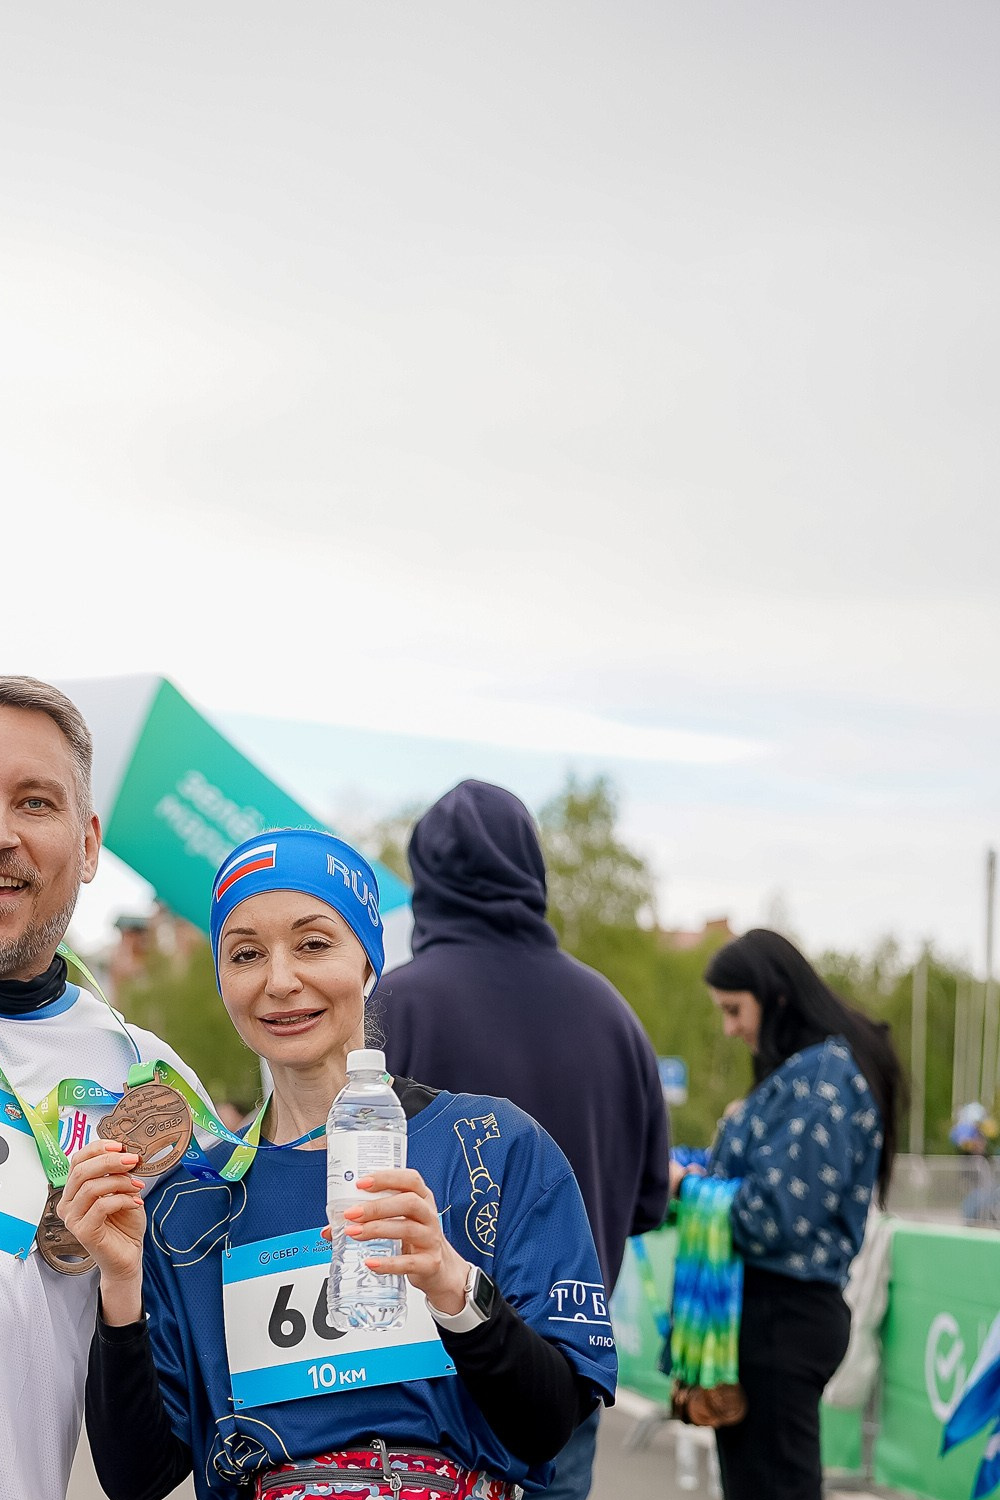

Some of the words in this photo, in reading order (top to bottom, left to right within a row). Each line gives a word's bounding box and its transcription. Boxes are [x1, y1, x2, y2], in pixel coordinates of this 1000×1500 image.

[157, 1116, 183, 1131] СБЕР
[272, 1246, 299, 1260] СБЕР
[588, 1335, 615, 1347] КЛЮ
